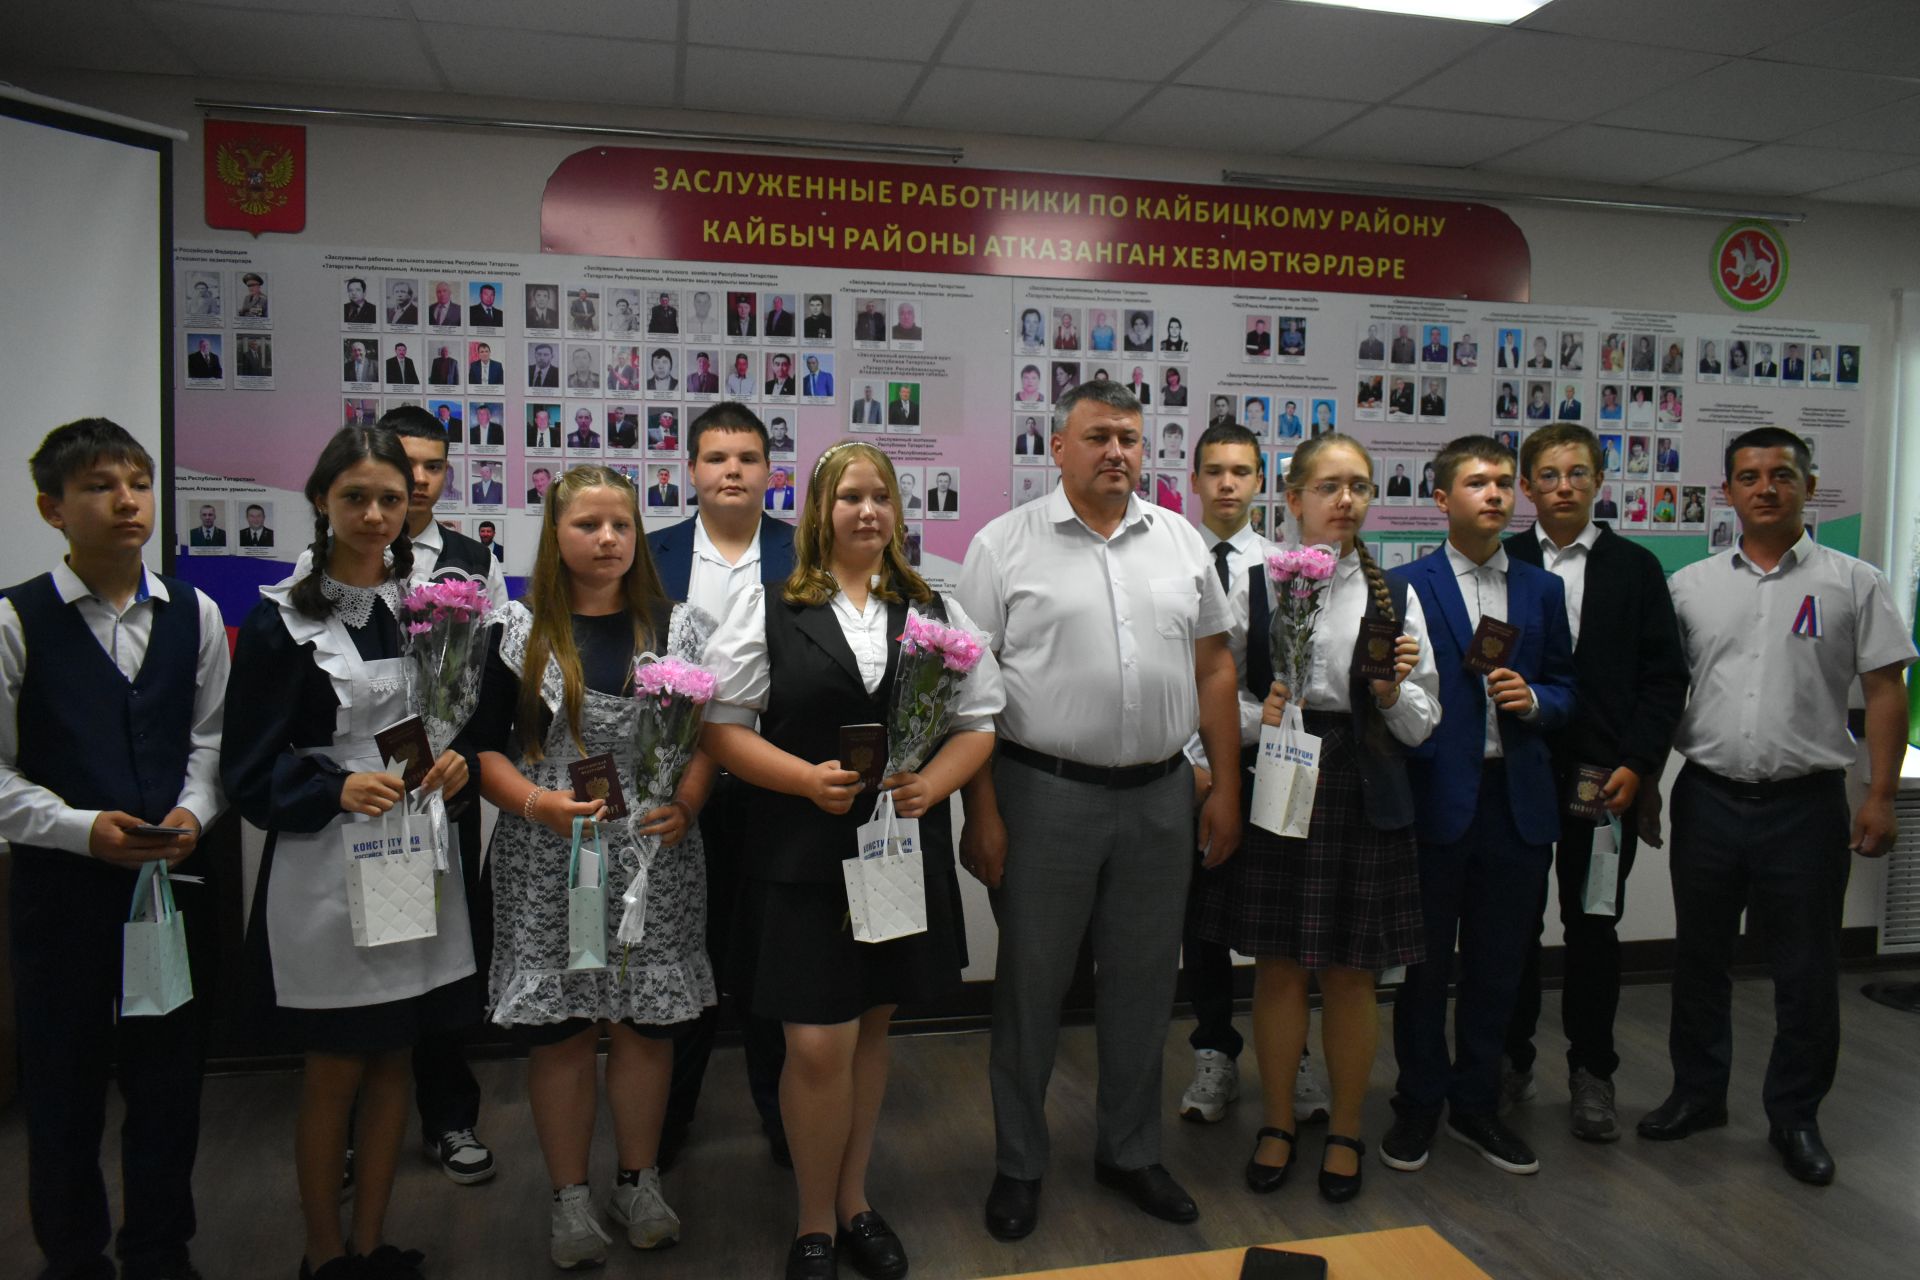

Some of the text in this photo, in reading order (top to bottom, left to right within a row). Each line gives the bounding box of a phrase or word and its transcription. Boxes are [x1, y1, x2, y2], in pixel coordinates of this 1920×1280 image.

[654, 167, 1446, 238] ЗАСЛУЖЕННЫЕ РАБОТНИКИ ПО КАЙБИЦКОМУ РАЙОНУ
[703, 216, 1406, 279] КАЙБЫЧ РАЙОНЫ АТКАЗАНГАН ХЕЗМӘТКӘРЛӘРЕ
